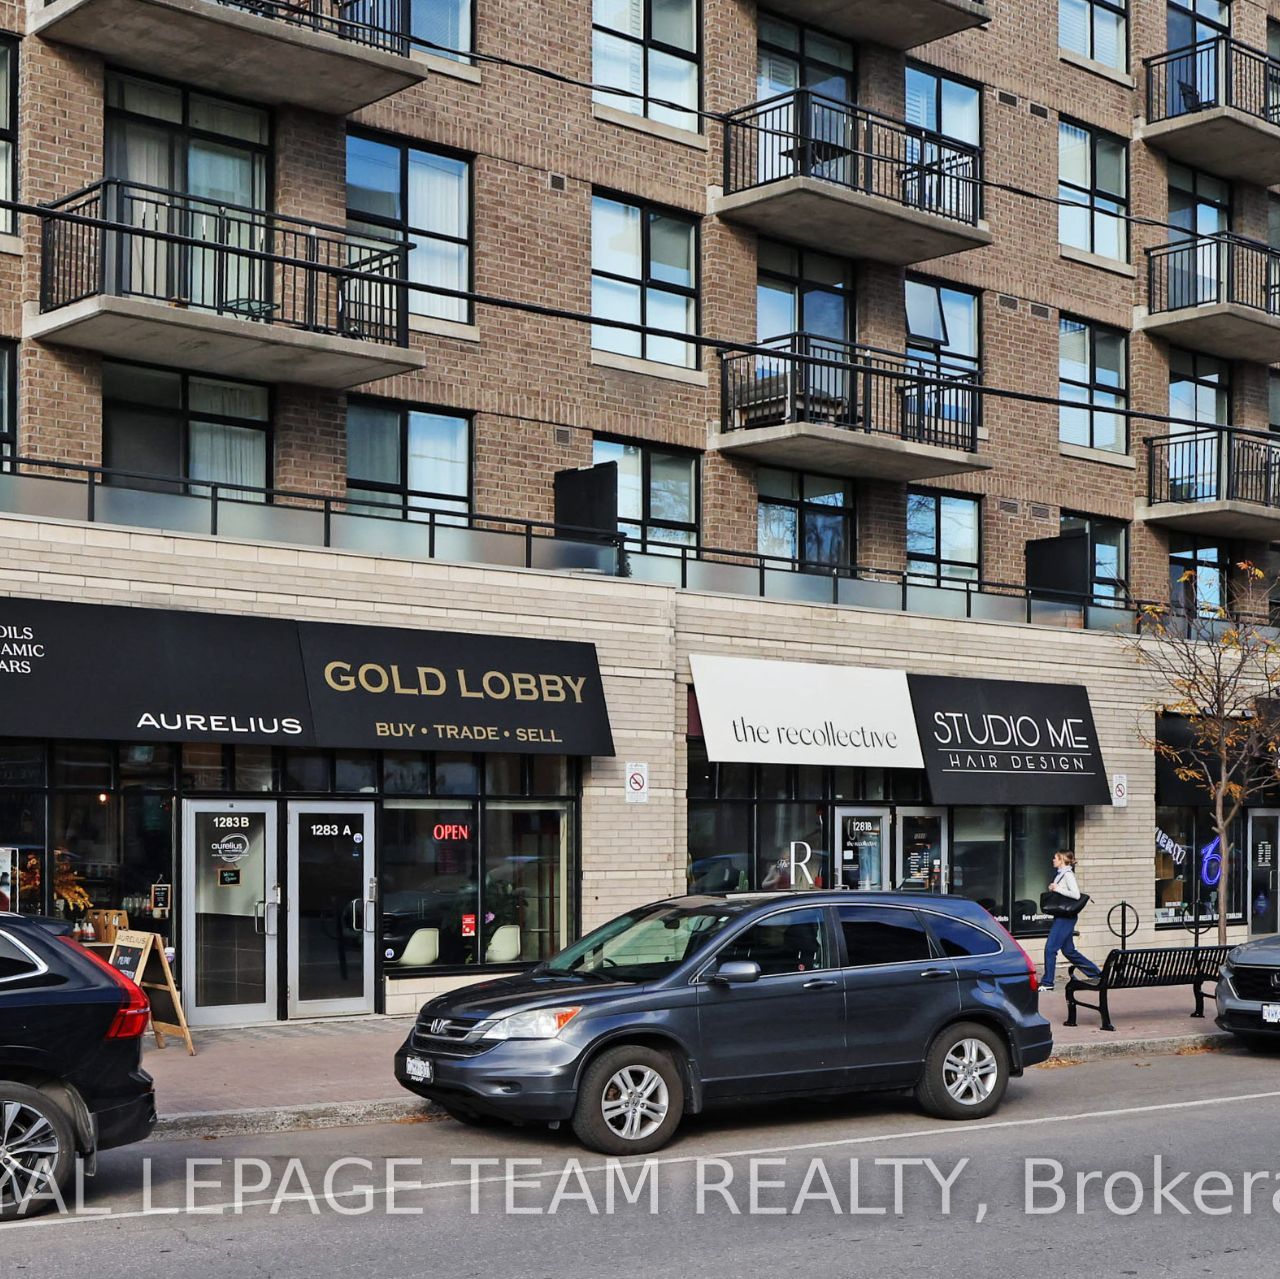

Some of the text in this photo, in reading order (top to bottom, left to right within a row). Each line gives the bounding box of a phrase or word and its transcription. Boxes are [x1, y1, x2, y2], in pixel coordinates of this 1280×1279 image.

[324, 661, 587, 704] GOLD LOBBY
[136, 712, 303, 735] AURELIUS
[375, 722, 563, 743] BUY TRADE SELL
[732, 716, 898, 749] the recollective
[933, 711, 1089, 749] STUDIO ME
[949, 753, 1084, 771] HAIR DESIGN
[310, 824, 352, 836] 1283 A
[433, 824, 469, 840] OPEN
[211, 841, 243, 850] aurelius
[789, 841, 815, 885] R
